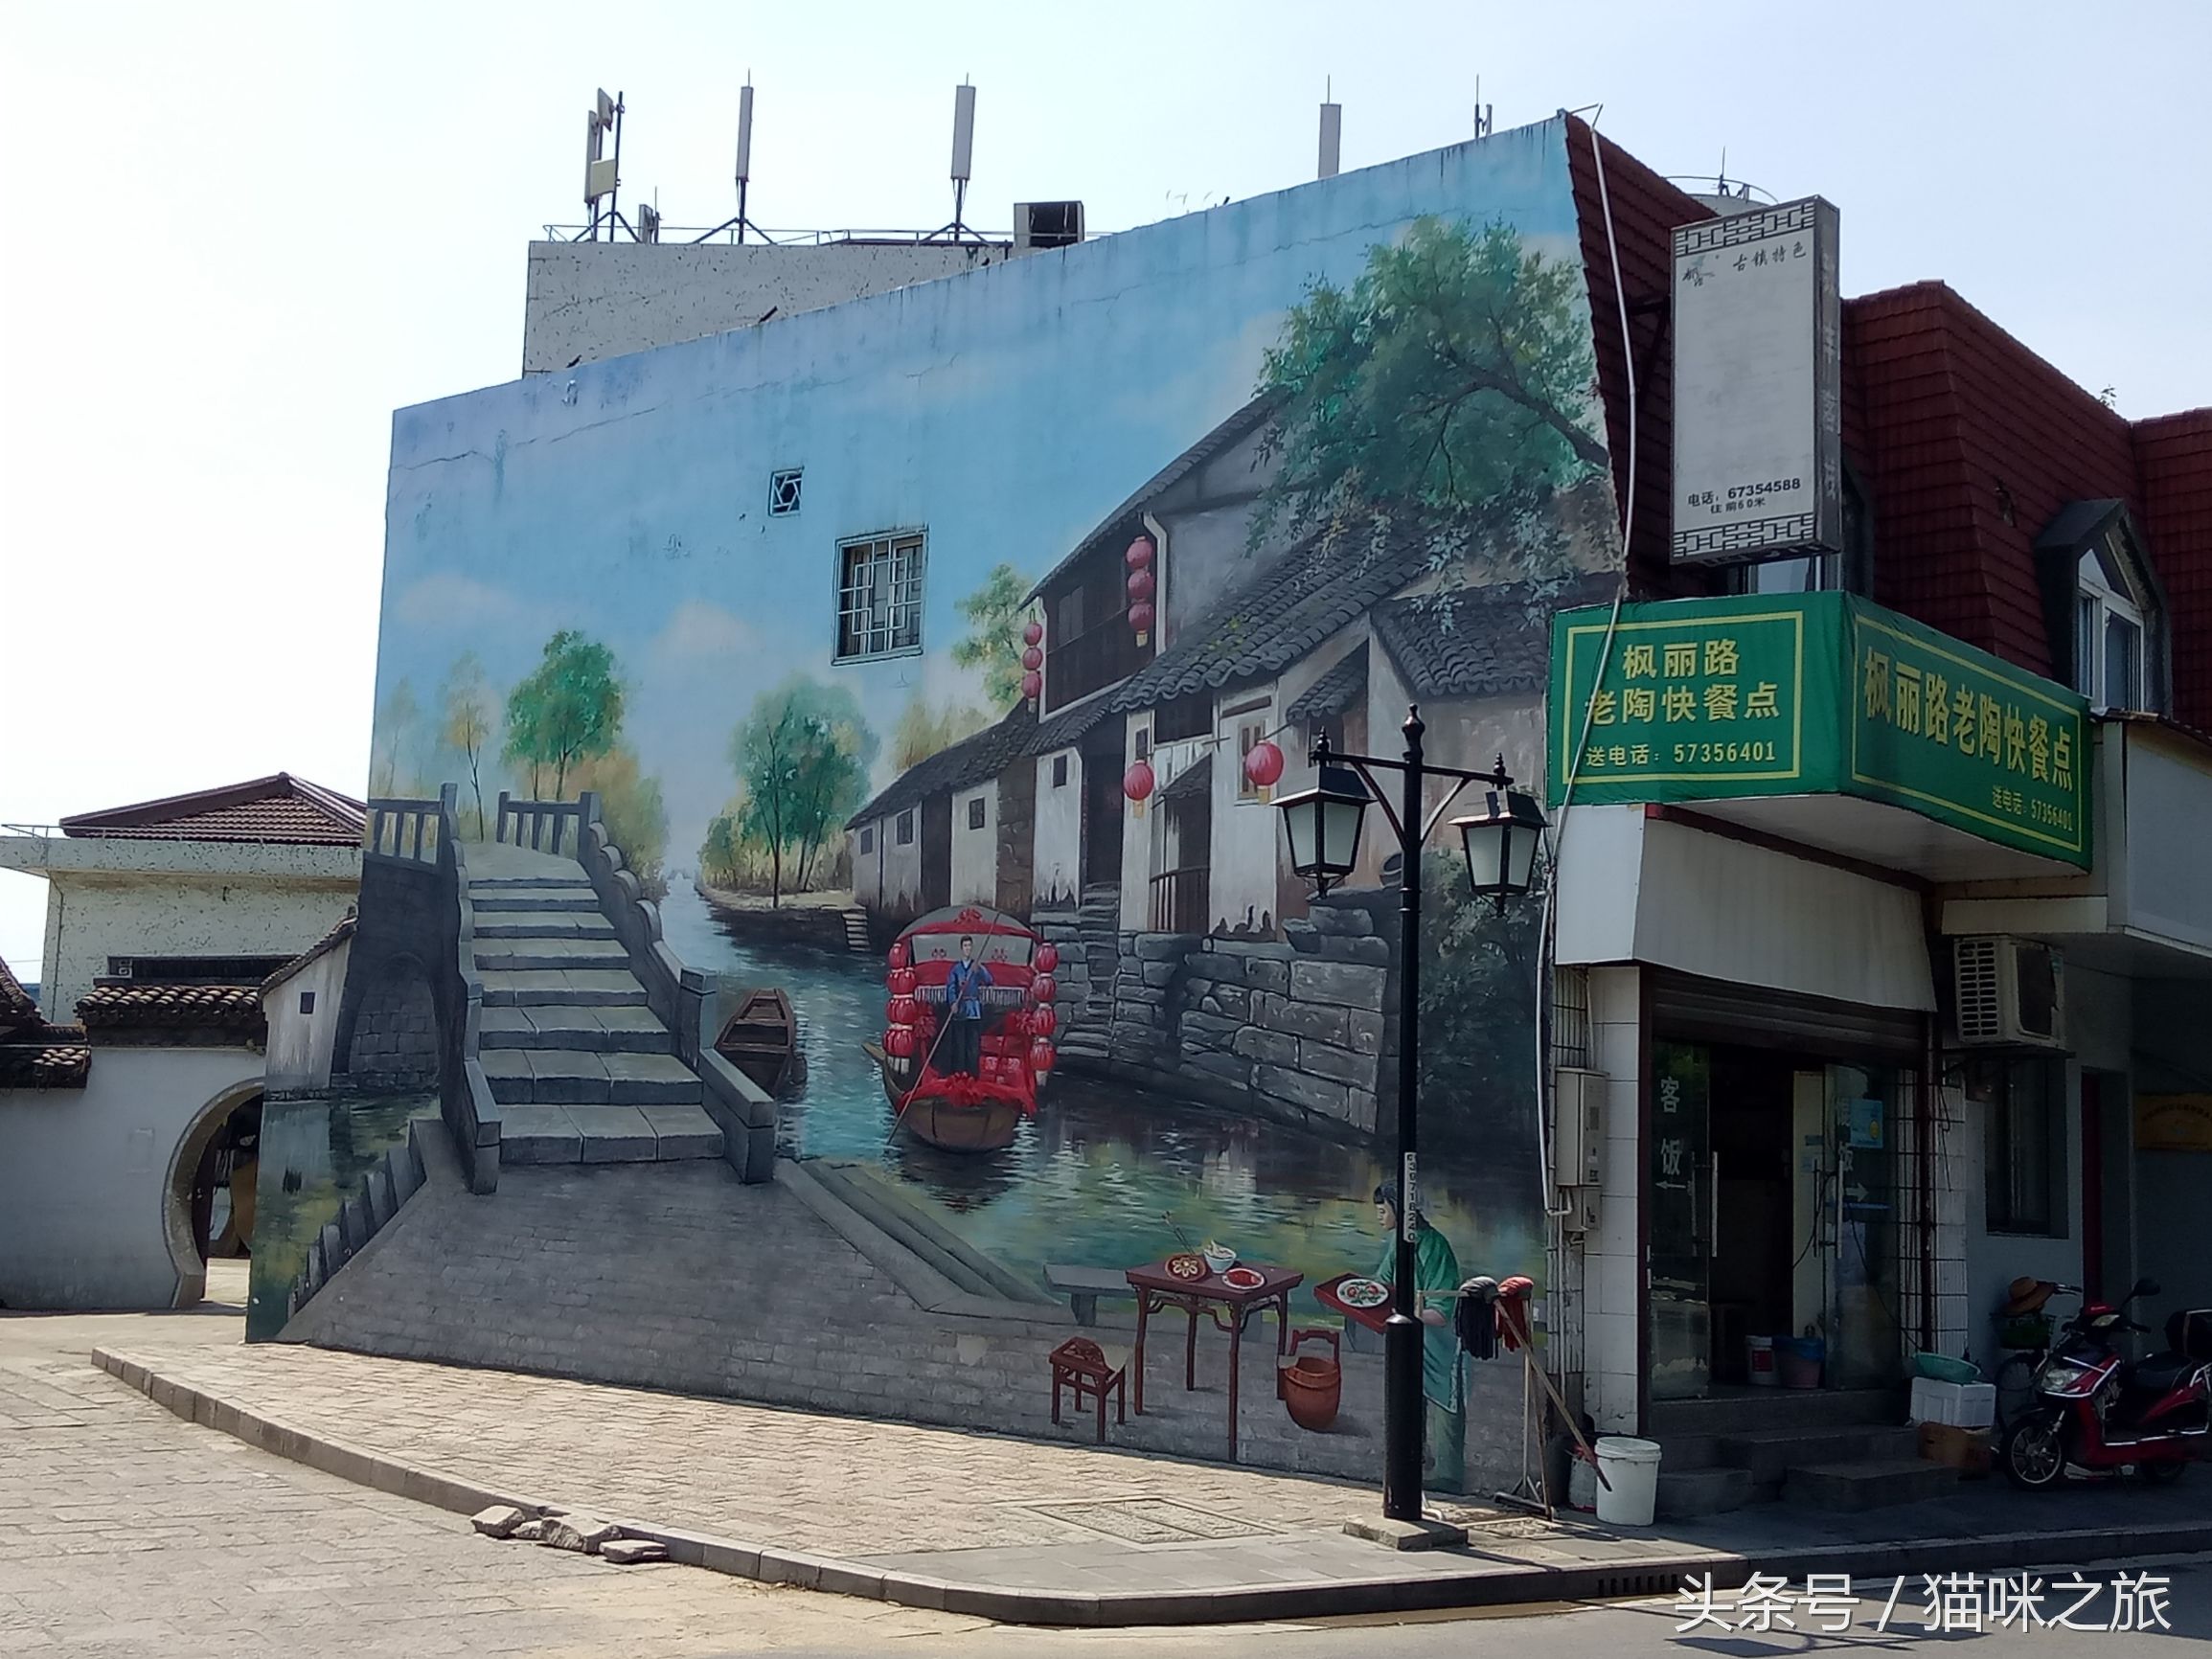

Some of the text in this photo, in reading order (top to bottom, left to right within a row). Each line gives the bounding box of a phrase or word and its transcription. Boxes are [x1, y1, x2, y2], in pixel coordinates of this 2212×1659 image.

[1623, 639, 1740, 680] 枫丽路
[1585, 681, 1780, 726] 老陶快餐点
[1864, 647, 2074, 792] 枫丽路老陶快餐点
[1660, 1076, 1683, 1176] 客饭
